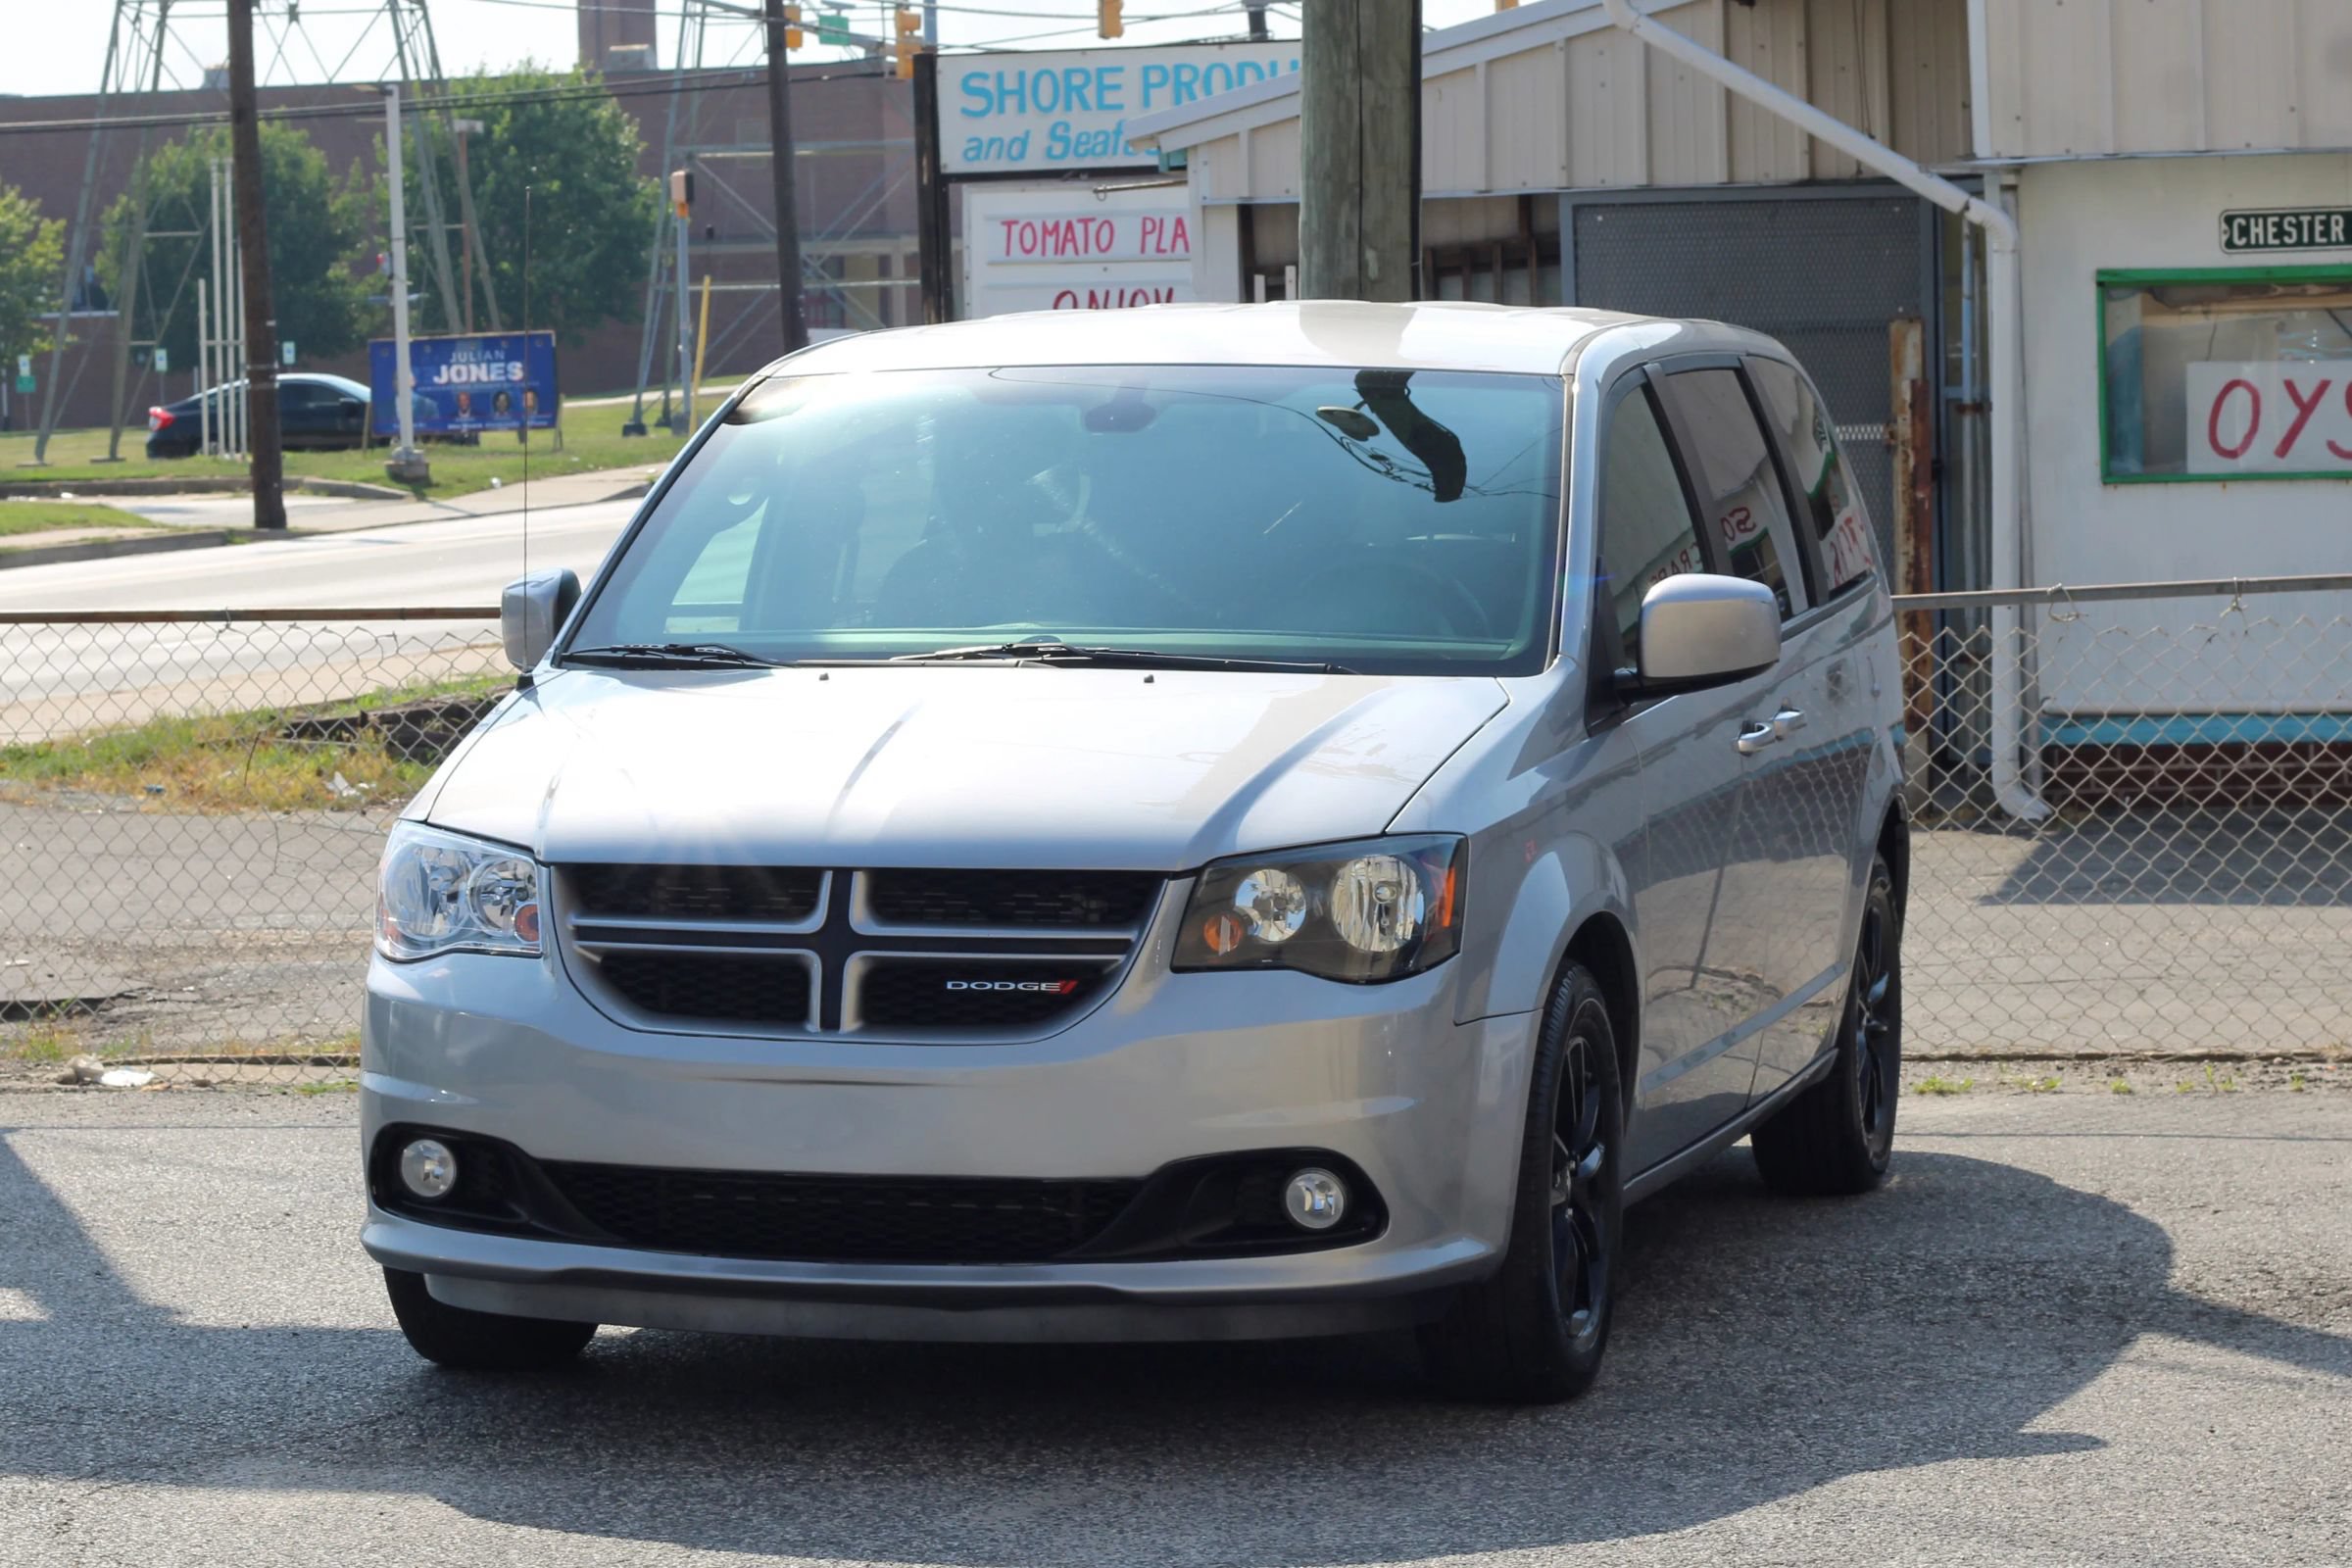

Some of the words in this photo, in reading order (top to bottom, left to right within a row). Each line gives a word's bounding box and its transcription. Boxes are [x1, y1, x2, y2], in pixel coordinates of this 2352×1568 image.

[960, 66, 1125, 118] SHORE
[962, 129, 1030, 162] and
[1046, 120, 1161, 161] Seaf
[1001, 217, 1115, 257] TOMATO
[1140, 216, 1191, 255] PLA
[2231, 215, 2345, 246] CHESTER
[450, 350, 506, 364] JULIAN
[432, 361, 524, 385] JONES
[946, 980, 1062, 992] DODGE
